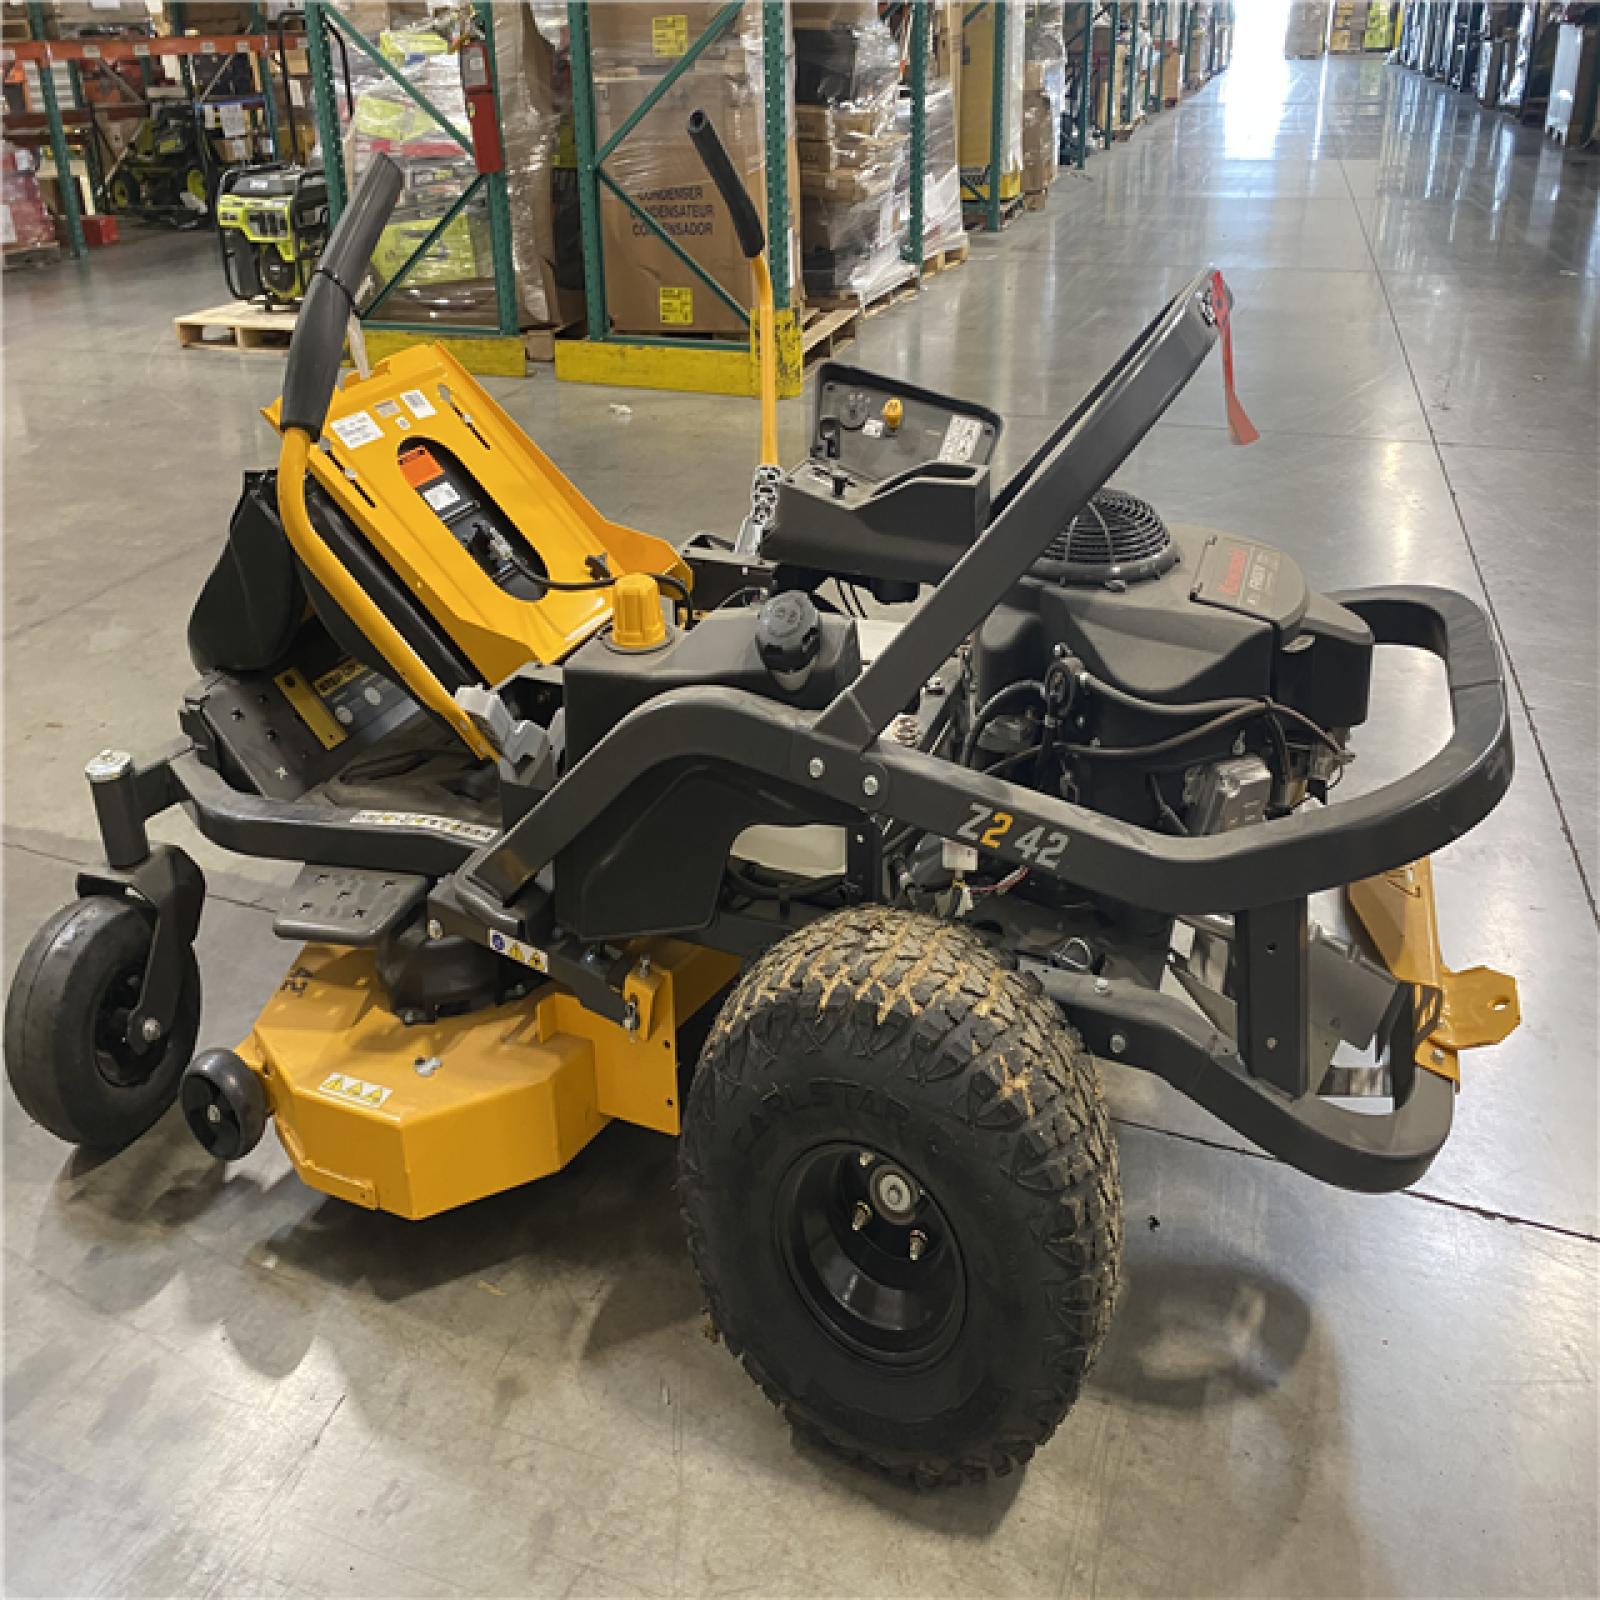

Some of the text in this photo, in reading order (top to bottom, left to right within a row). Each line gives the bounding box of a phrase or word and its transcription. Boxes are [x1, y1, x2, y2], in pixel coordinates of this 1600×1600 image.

[630, 204, 715, 218] CNDENSATEUR
[632, 222, 713, 236] COENSADOR
[956, 802, 1070, 871] Z2 42
